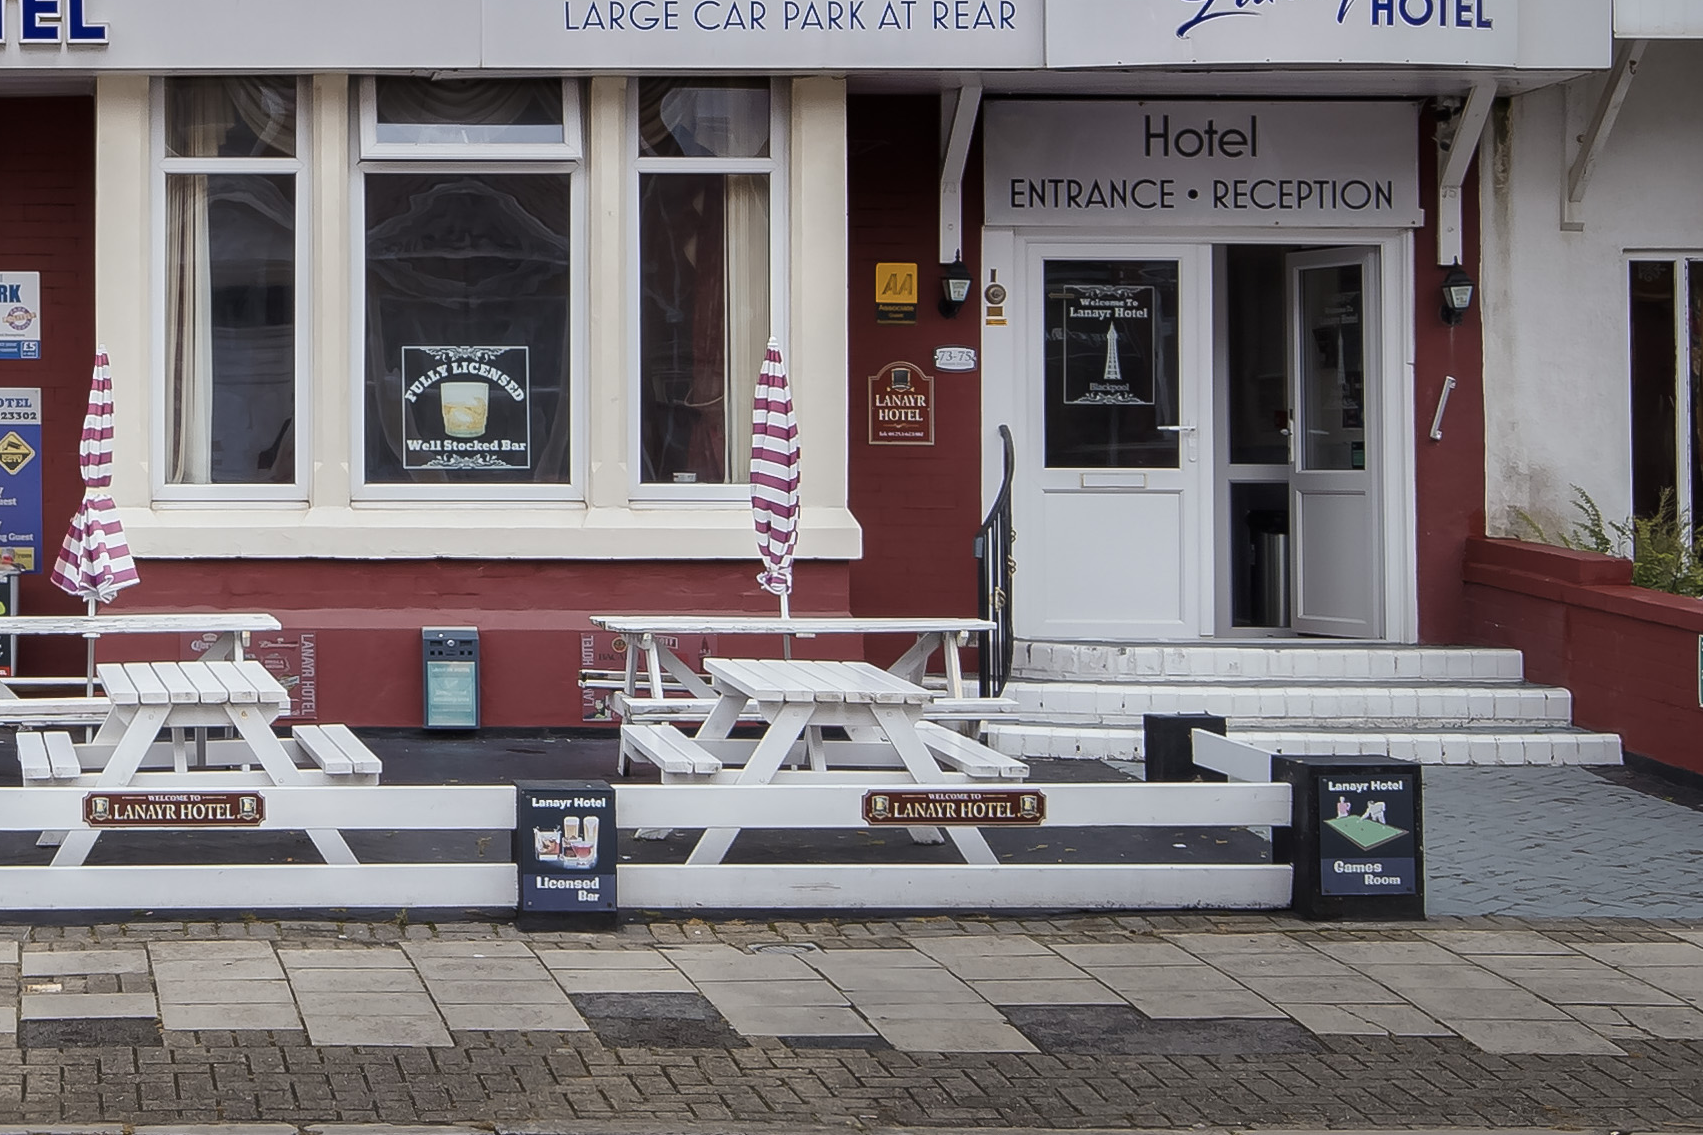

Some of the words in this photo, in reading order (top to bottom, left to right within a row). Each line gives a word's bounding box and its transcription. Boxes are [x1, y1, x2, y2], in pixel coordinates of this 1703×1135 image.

[564, 0, 680, 31] LARGE
[693, 0, 767, 31] CAR
[783, 0, 866, 31] PARK
[877, 0, 917, 31] AT
[933, 0, 1017, 31] REAR
[1144, 115, 1258, 158] Hotel
[1010, 178, 1175, 210] ENTRANCE
[1213, 179, 1394, 210] RECEPTION
[882, 273, 913, 296] AA
[1080, 298, 1124, 307] Welcome
[1126, 298, 1138, 307] To
[1070, 307, 1112, 320] Lanayr
[1114, 307, 1148, 318] Hotel
[23, 342, 36, 351] £5
[938, 350, 972, 362] 73-75
[404, 364, 449, 403] FULLY
[451, 361, 525, 402] LICENSED
[1089, 383, 1130, 393] Blackpool
[875, 394, 927, 407] LANAYR
[878, 409, 924, 421] HOTEL
[406, 440, 442, 451] Well
[443, 439, 499, 451] Stocked
[501, 439, 527, 451] Bar
[8, 532, 34, 541] Guest
[300, 634, 315, 677] LANAYR
[582, 635, 594, 666] HOTEL
[301, 680, 316, 715] HOTEL
[1328, 781, 1369, 793] Lanayr
[1370, 780, 1403, 791] Hotel
[148, 794, 188, 802] WELCOME
[189, 794, 201, 802] TO
[531, 797, 572, 810] Lanayr
[574, 797, 606, 808] Hotel
[113, 803, 177, 820] LANAYR
[180, 803, 236, 820] HOTEL
[893, 802, 957, 818] LANAYR
[960, 802, 1016, 818] HOTEL
[1333, 860, 1383, 873] Games
[536, 876, 600, 889] Licensed
[1364, 874, 1401, 885] Room
[577, 890, 600, 901] Bar
